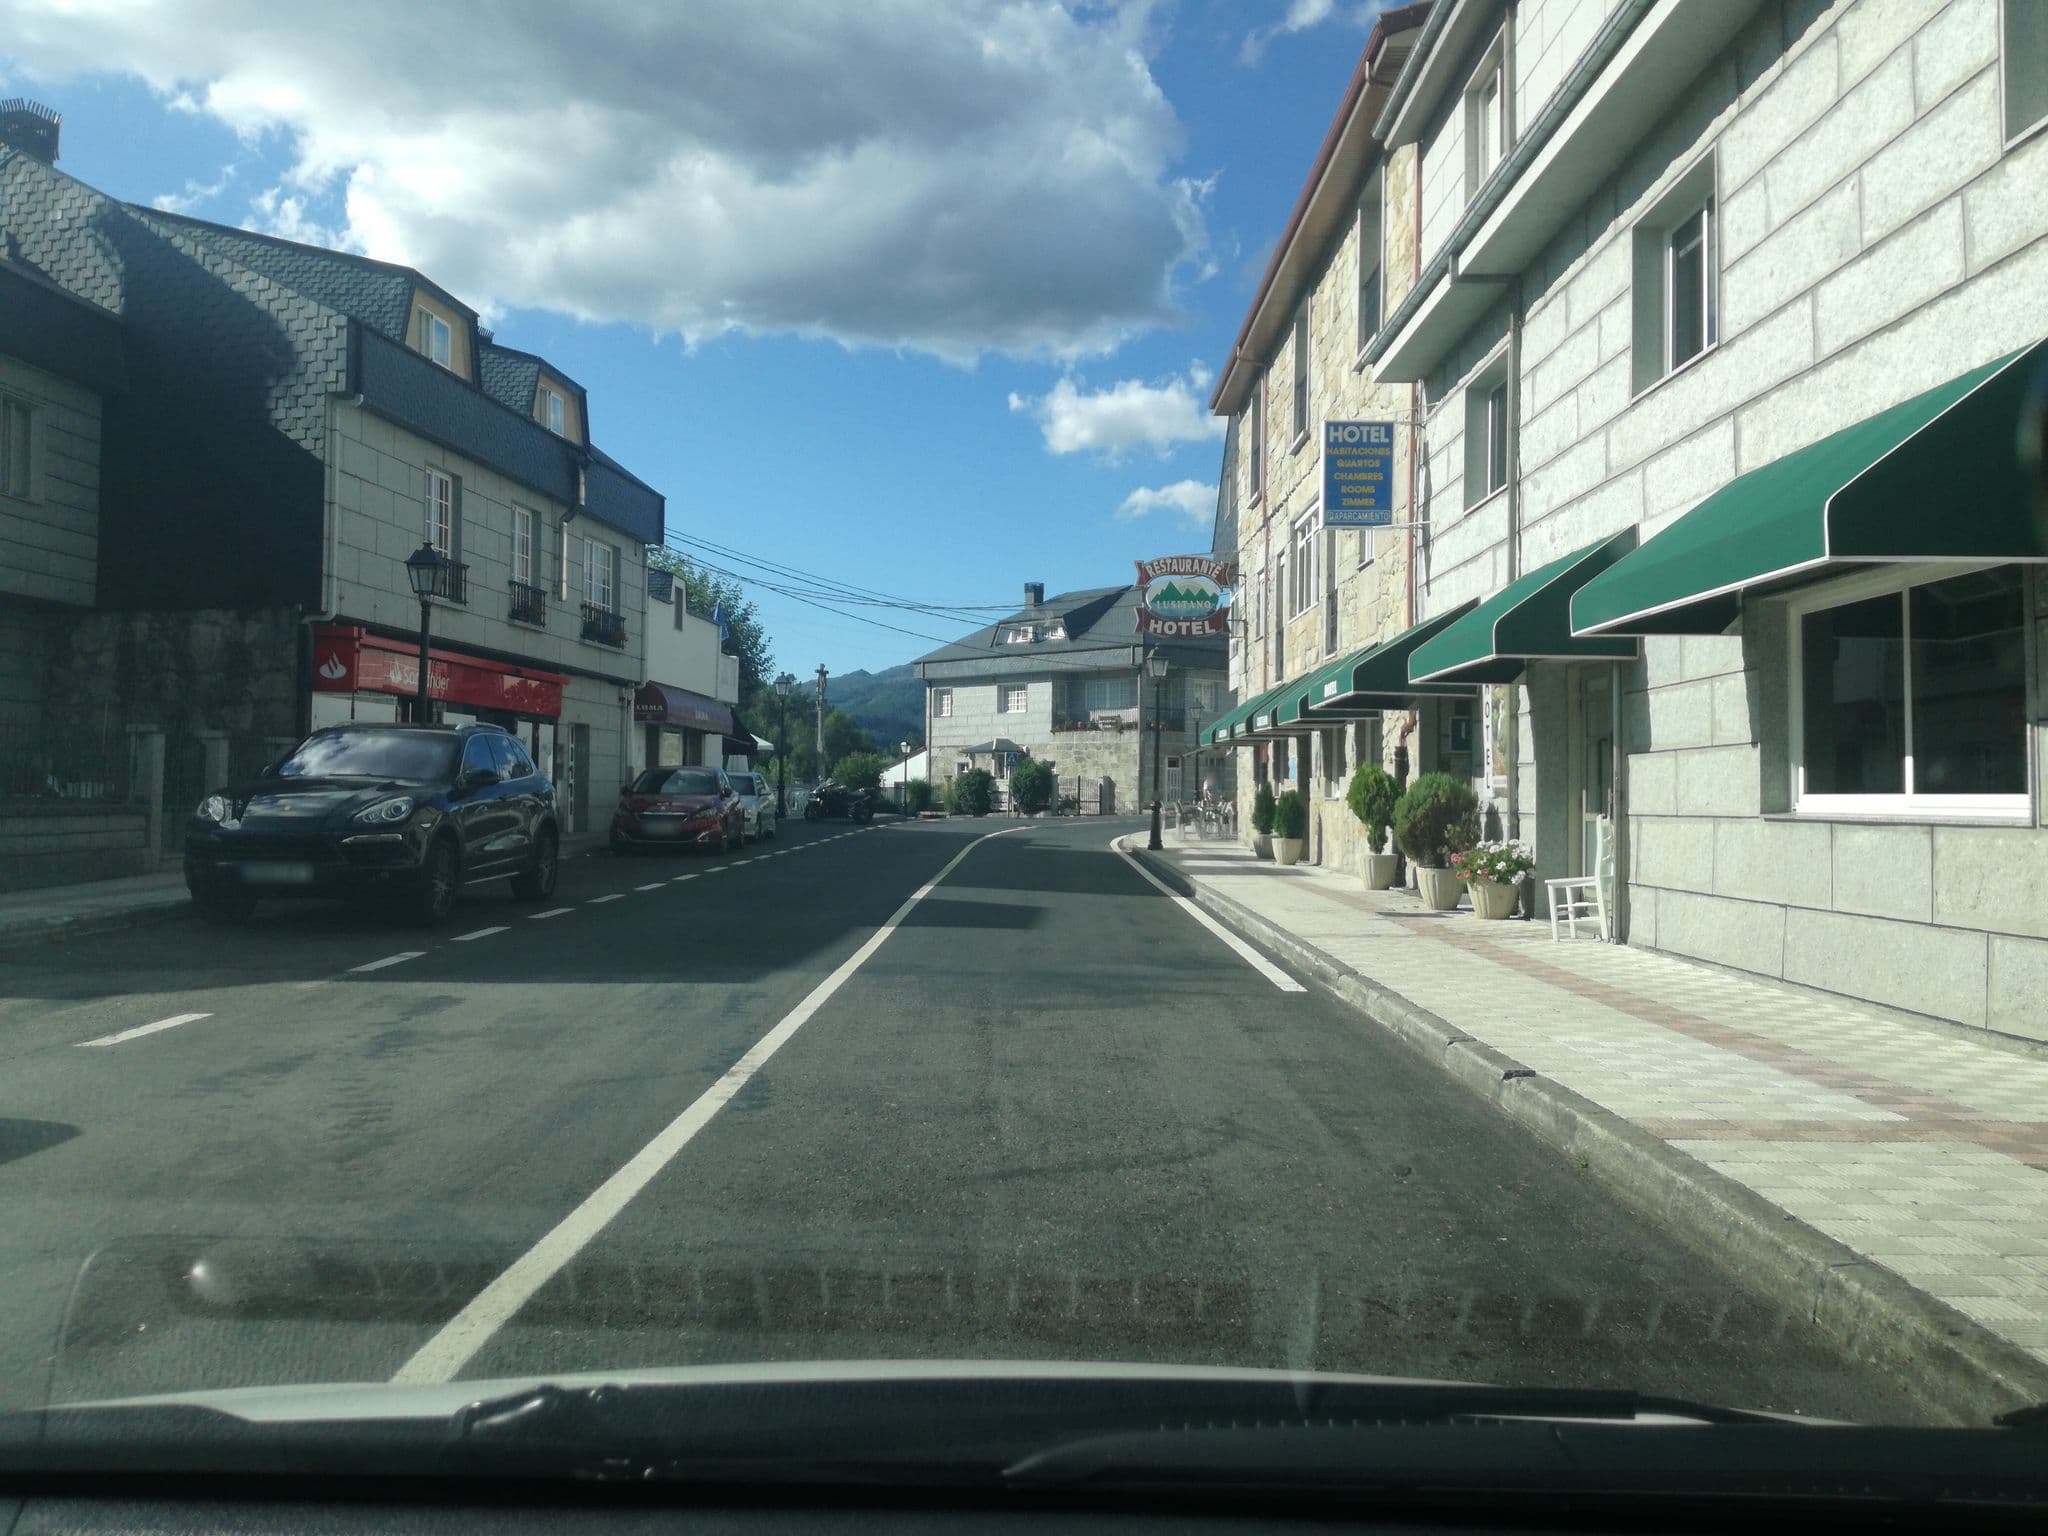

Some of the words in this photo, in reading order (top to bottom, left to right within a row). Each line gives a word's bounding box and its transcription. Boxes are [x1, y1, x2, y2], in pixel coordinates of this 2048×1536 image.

[1328, 425, 1390, 443] HOTEL
[1326, 447, 1391, 456] HABITACIONES
[1336, 459, 1380, 468] QUARTOS
[1334, 472, 1384, 481] CHAMBRES
[1341, 485, 1376, 494] ROOMS
[1342, 498, 1376, 506] ZIMMER
[1334, 511, 1389, 520] APARCAMIENTO
[1145, 558, 1222, 578] RESTAURANTE
[1156, 600, 1211, 609] LUSITANO
[1149, 619, 1216, 635] HOTEL
